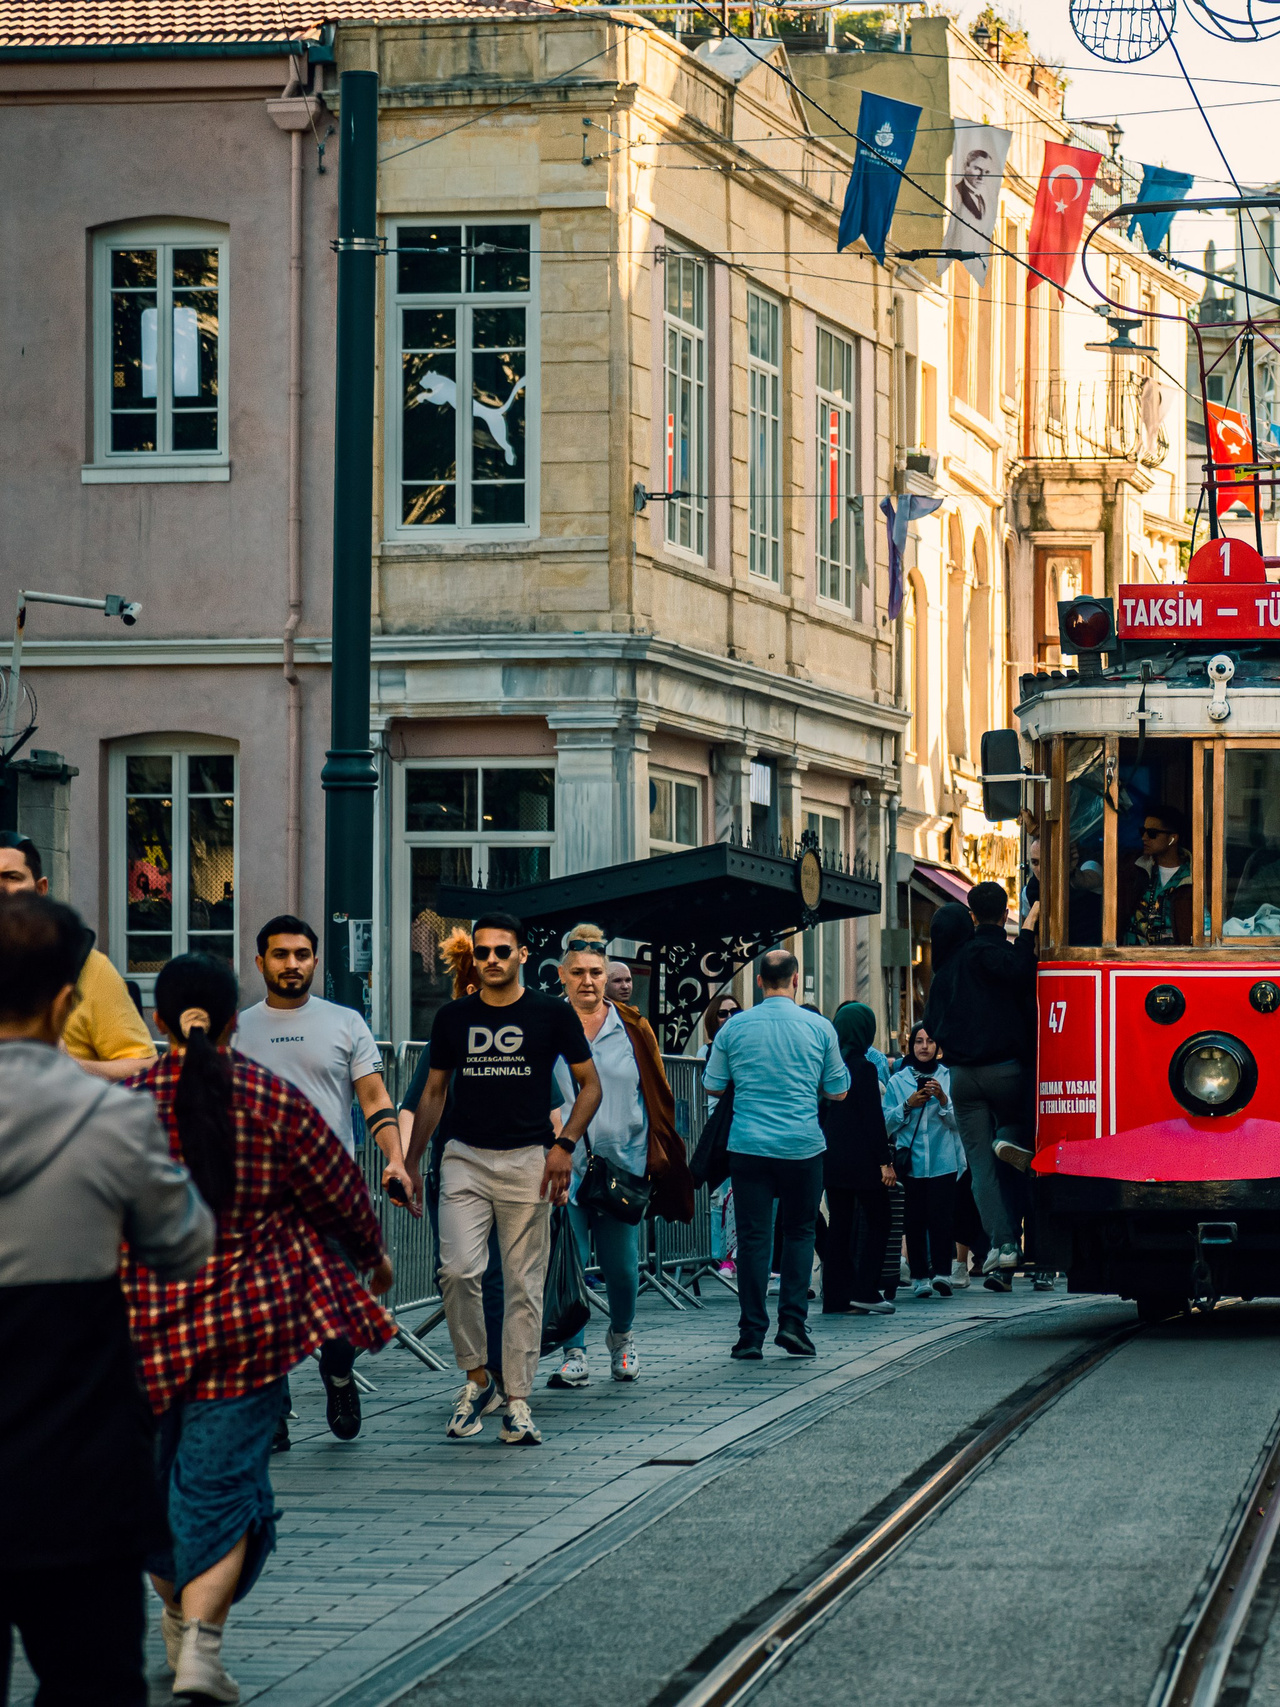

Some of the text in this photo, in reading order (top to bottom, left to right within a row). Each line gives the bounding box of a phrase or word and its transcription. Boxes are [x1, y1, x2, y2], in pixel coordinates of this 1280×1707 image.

[1219, 541, 1231, 577] 1
[1122, 591, 1203, 627] TAKSİM
[1048, 1001, 1067, 1033] 47
[468, 1025, 524, 1054] DG
[462, 1066, 531, 1076] MILLENNIALS
[1066, 1080, 1096, 1095] YASAK
[1045, 1096, 1096, 1114] TEHLİKELİDİR
